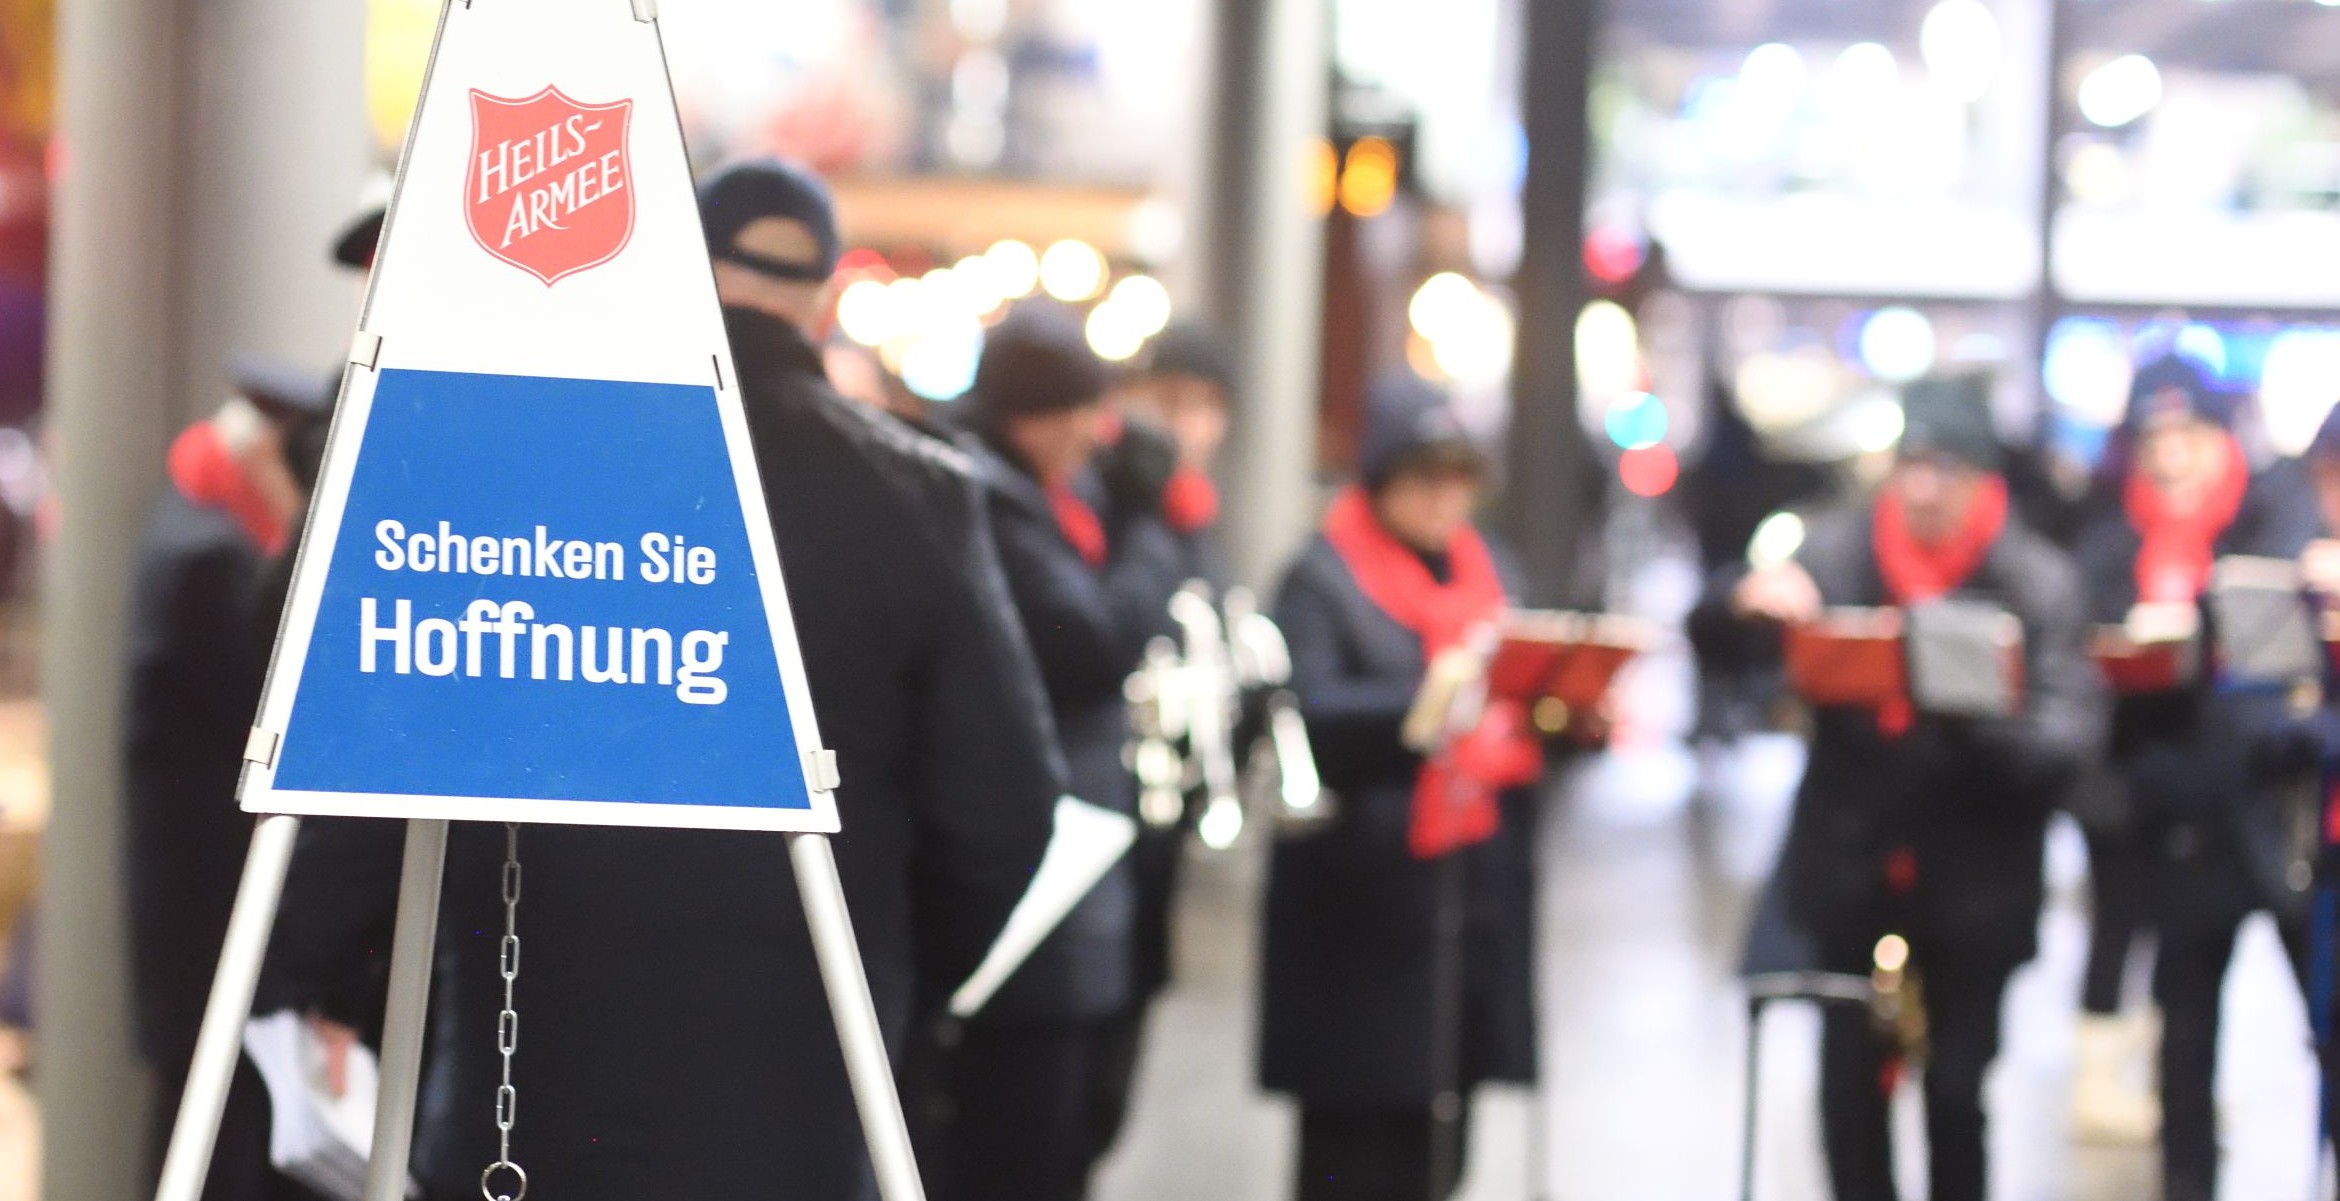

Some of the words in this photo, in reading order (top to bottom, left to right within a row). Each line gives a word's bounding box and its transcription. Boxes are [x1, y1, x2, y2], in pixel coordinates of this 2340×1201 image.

[499, 149, 625, 250] ARMEE
[374, 519, 625, 581] Schenken
[639, 531, 717, 585] Sie
[359, 597, 729, 706] Hoffnung
